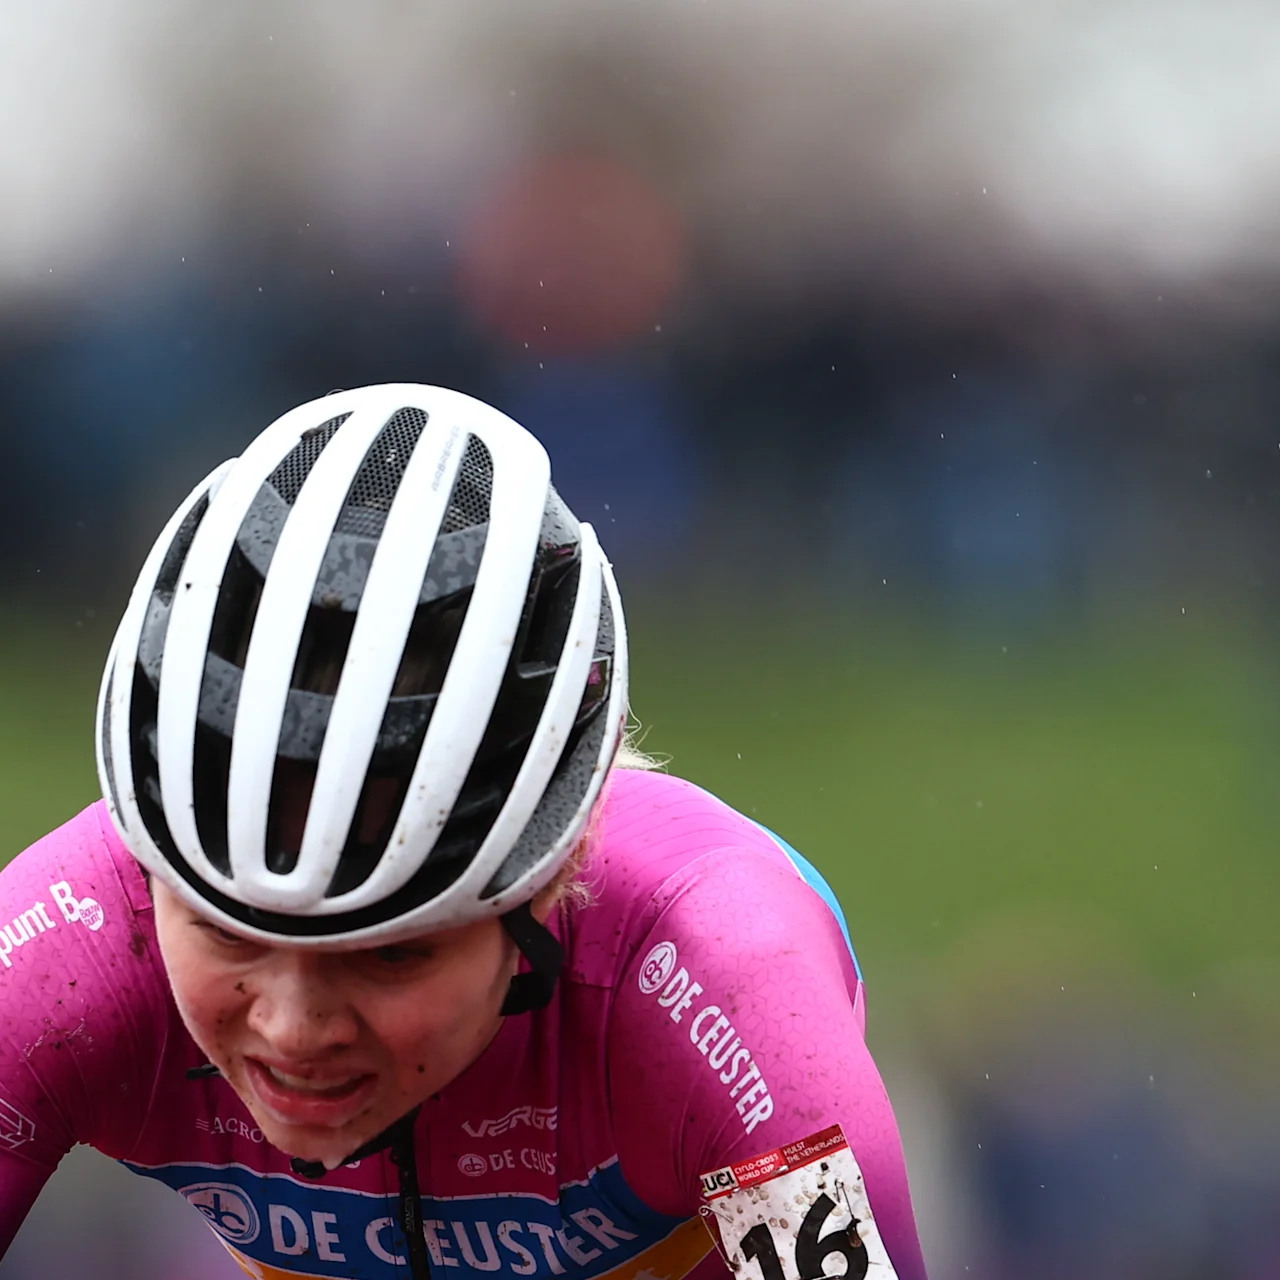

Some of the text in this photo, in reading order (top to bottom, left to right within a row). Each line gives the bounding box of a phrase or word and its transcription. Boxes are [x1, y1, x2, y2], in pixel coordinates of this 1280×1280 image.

[657, 967, 704, 1024] DE
[690, 1005, 774, 1135] CEUSTER
[488, 1148, 516, 1171] DE
[783, 1141, 805, 1156] HULST
[733, 1152, 779, 1176] CYCLO-CROSS
[738, 1163, 775, 1182] WORLD CUP
[704, 1170, 736, 1193] UCI
[269, 1202, 346, 1264] DE
[364, 1205, 639, 1276] CEUSTER
